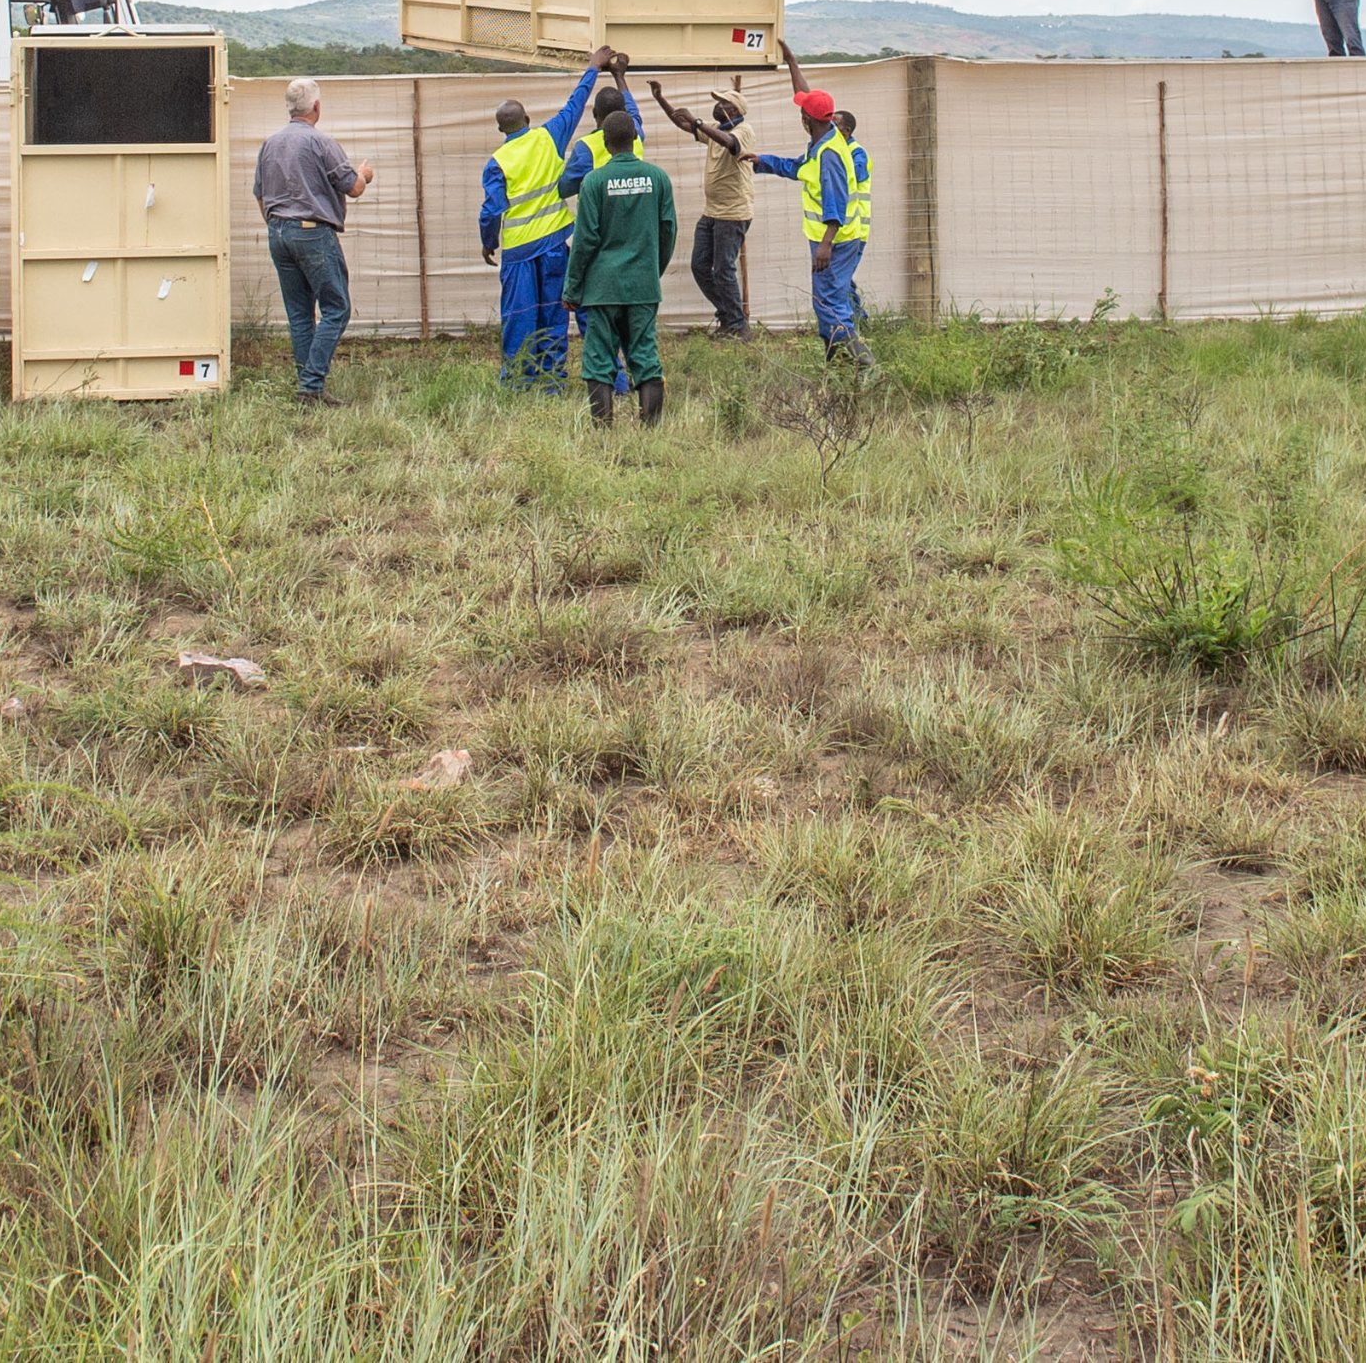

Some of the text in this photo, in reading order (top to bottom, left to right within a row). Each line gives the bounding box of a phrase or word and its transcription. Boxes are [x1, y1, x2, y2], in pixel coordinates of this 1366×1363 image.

[747, 33, 764, 48] 27
[607, 176, 653, 189] AKAGERA
[201, 363, 210, 378] 7
